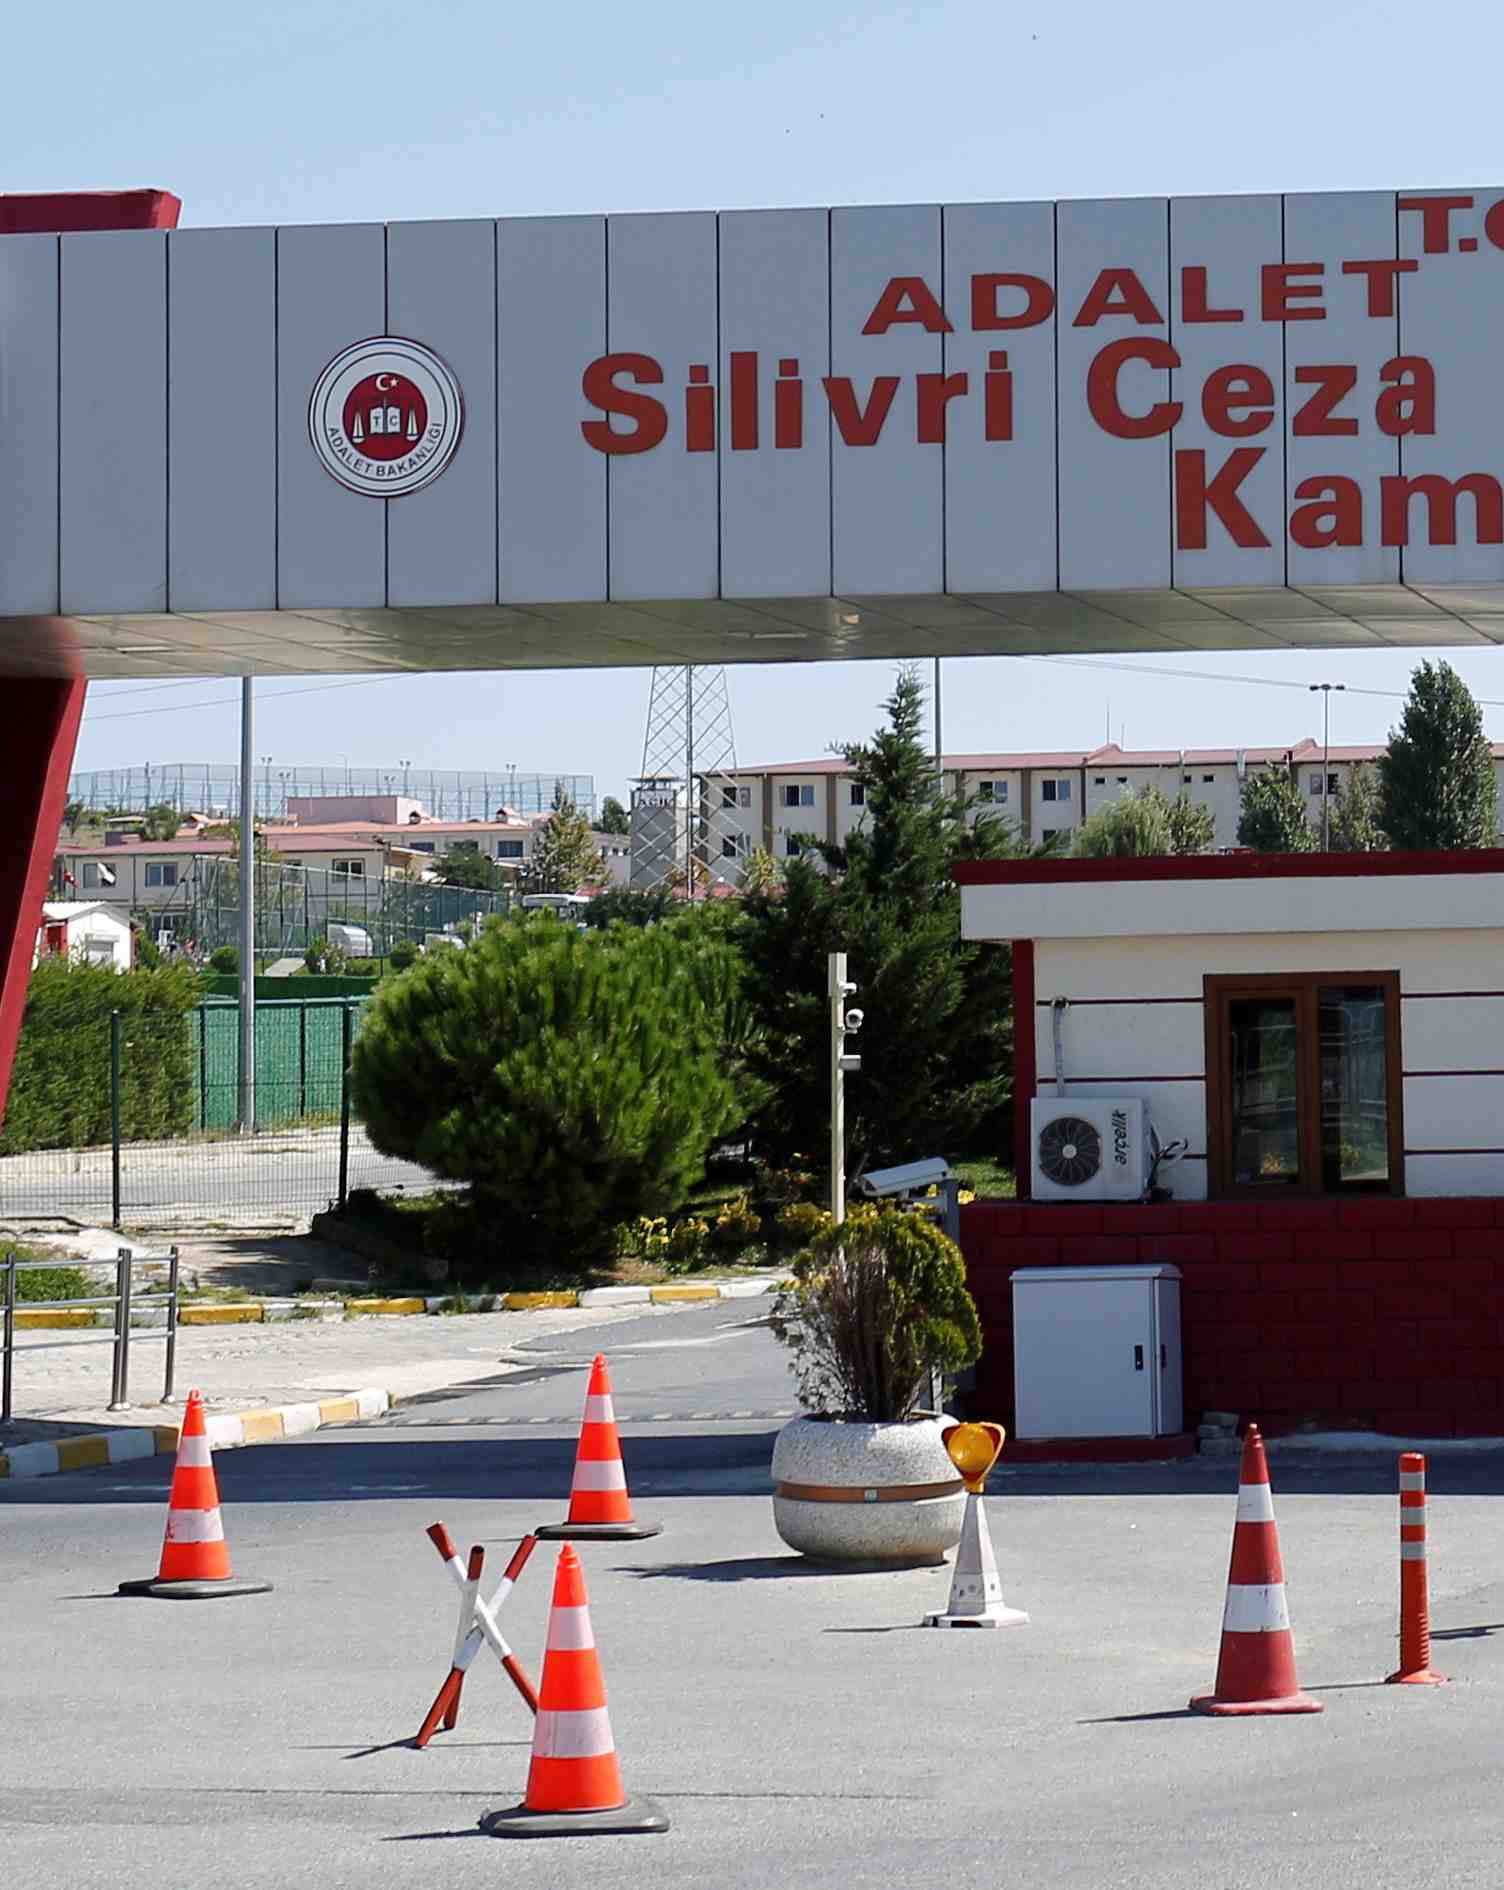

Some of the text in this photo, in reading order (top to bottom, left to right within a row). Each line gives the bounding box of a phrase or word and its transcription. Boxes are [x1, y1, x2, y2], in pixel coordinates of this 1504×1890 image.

[861, 259, 1418, 336] ADALET
[581, 350, 1014, 455] Silivri
[1086, 336, 1436, 439] Ceza
[328, 427, 373, 475] ADALET
[1112, 1109, 1130, 1165] arçelik
